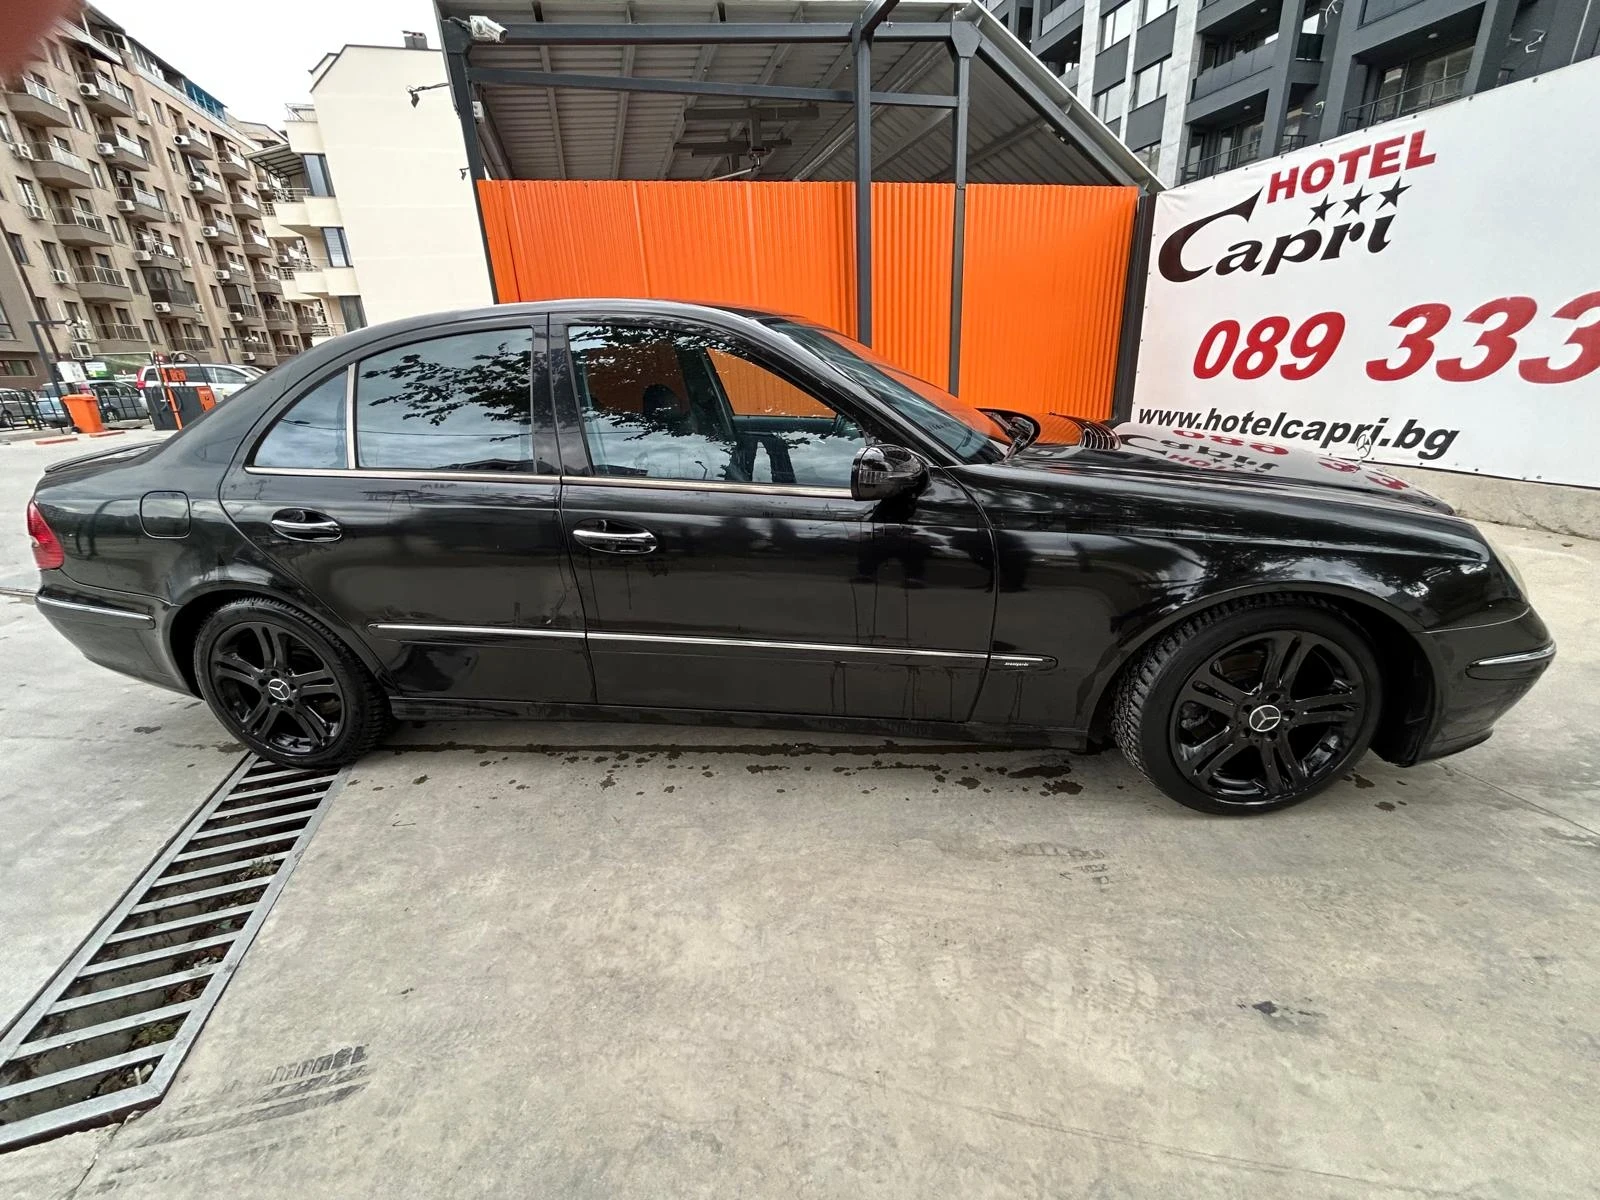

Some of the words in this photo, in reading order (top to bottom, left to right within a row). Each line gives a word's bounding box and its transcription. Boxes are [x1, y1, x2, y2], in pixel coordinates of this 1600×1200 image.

[1266, 129, 1437, 204] HOTEL
[1157, 186, 1396, 283] Capri
[1192, 311, 1347, 381] 089
[1365, 290, 1600, 384] 333
[1138, 407, 1460, 461] www.hotelcapri.bg
